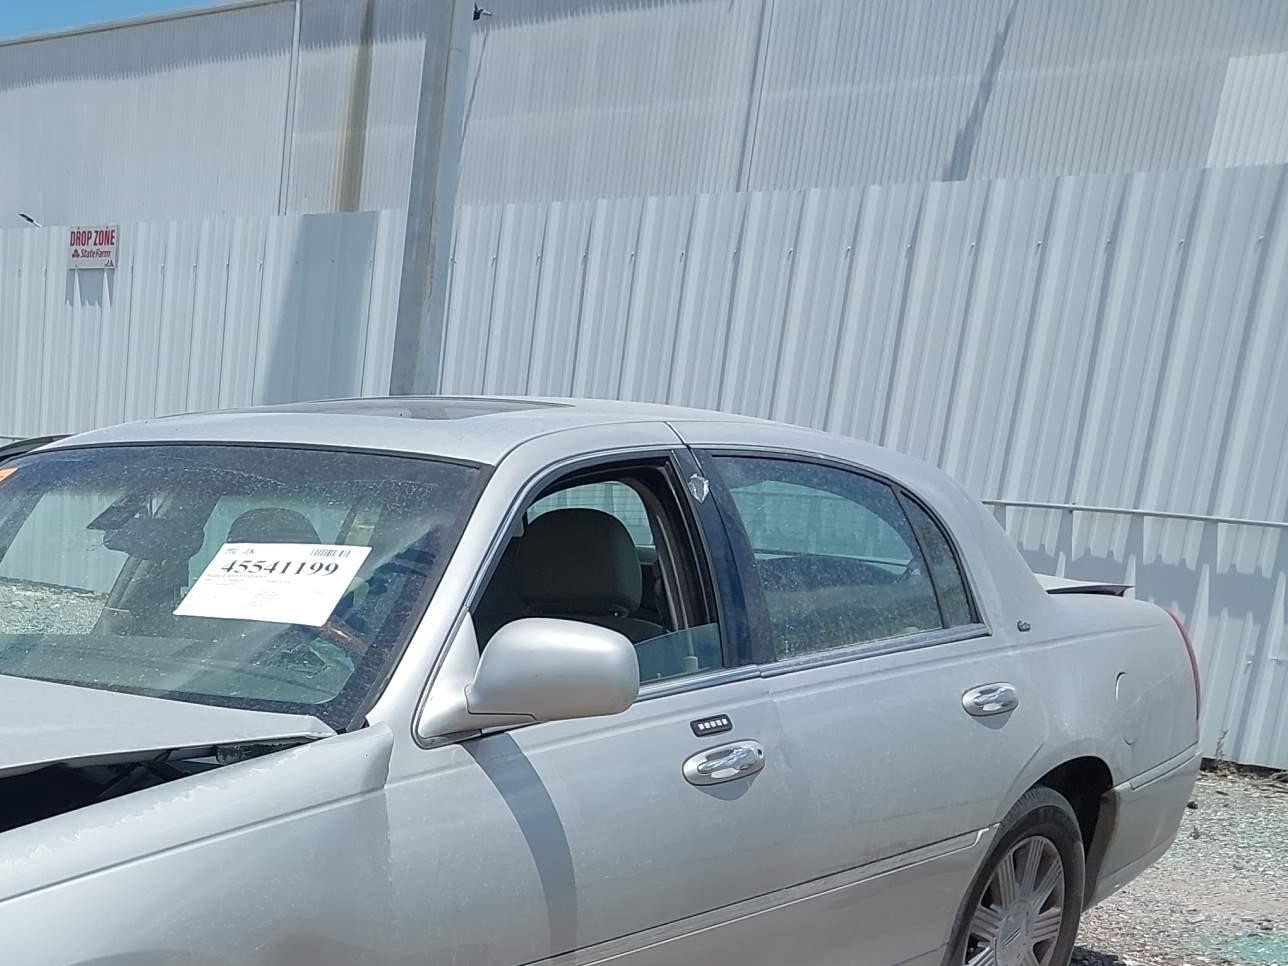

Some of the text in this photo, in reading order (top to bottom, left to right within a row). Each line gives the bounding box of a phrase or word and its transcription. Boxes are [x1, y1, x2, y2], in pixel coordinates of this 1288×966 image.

[70, 229, 116, 247] DROP ZONE
[220, 559, 340, 577] 45541199
